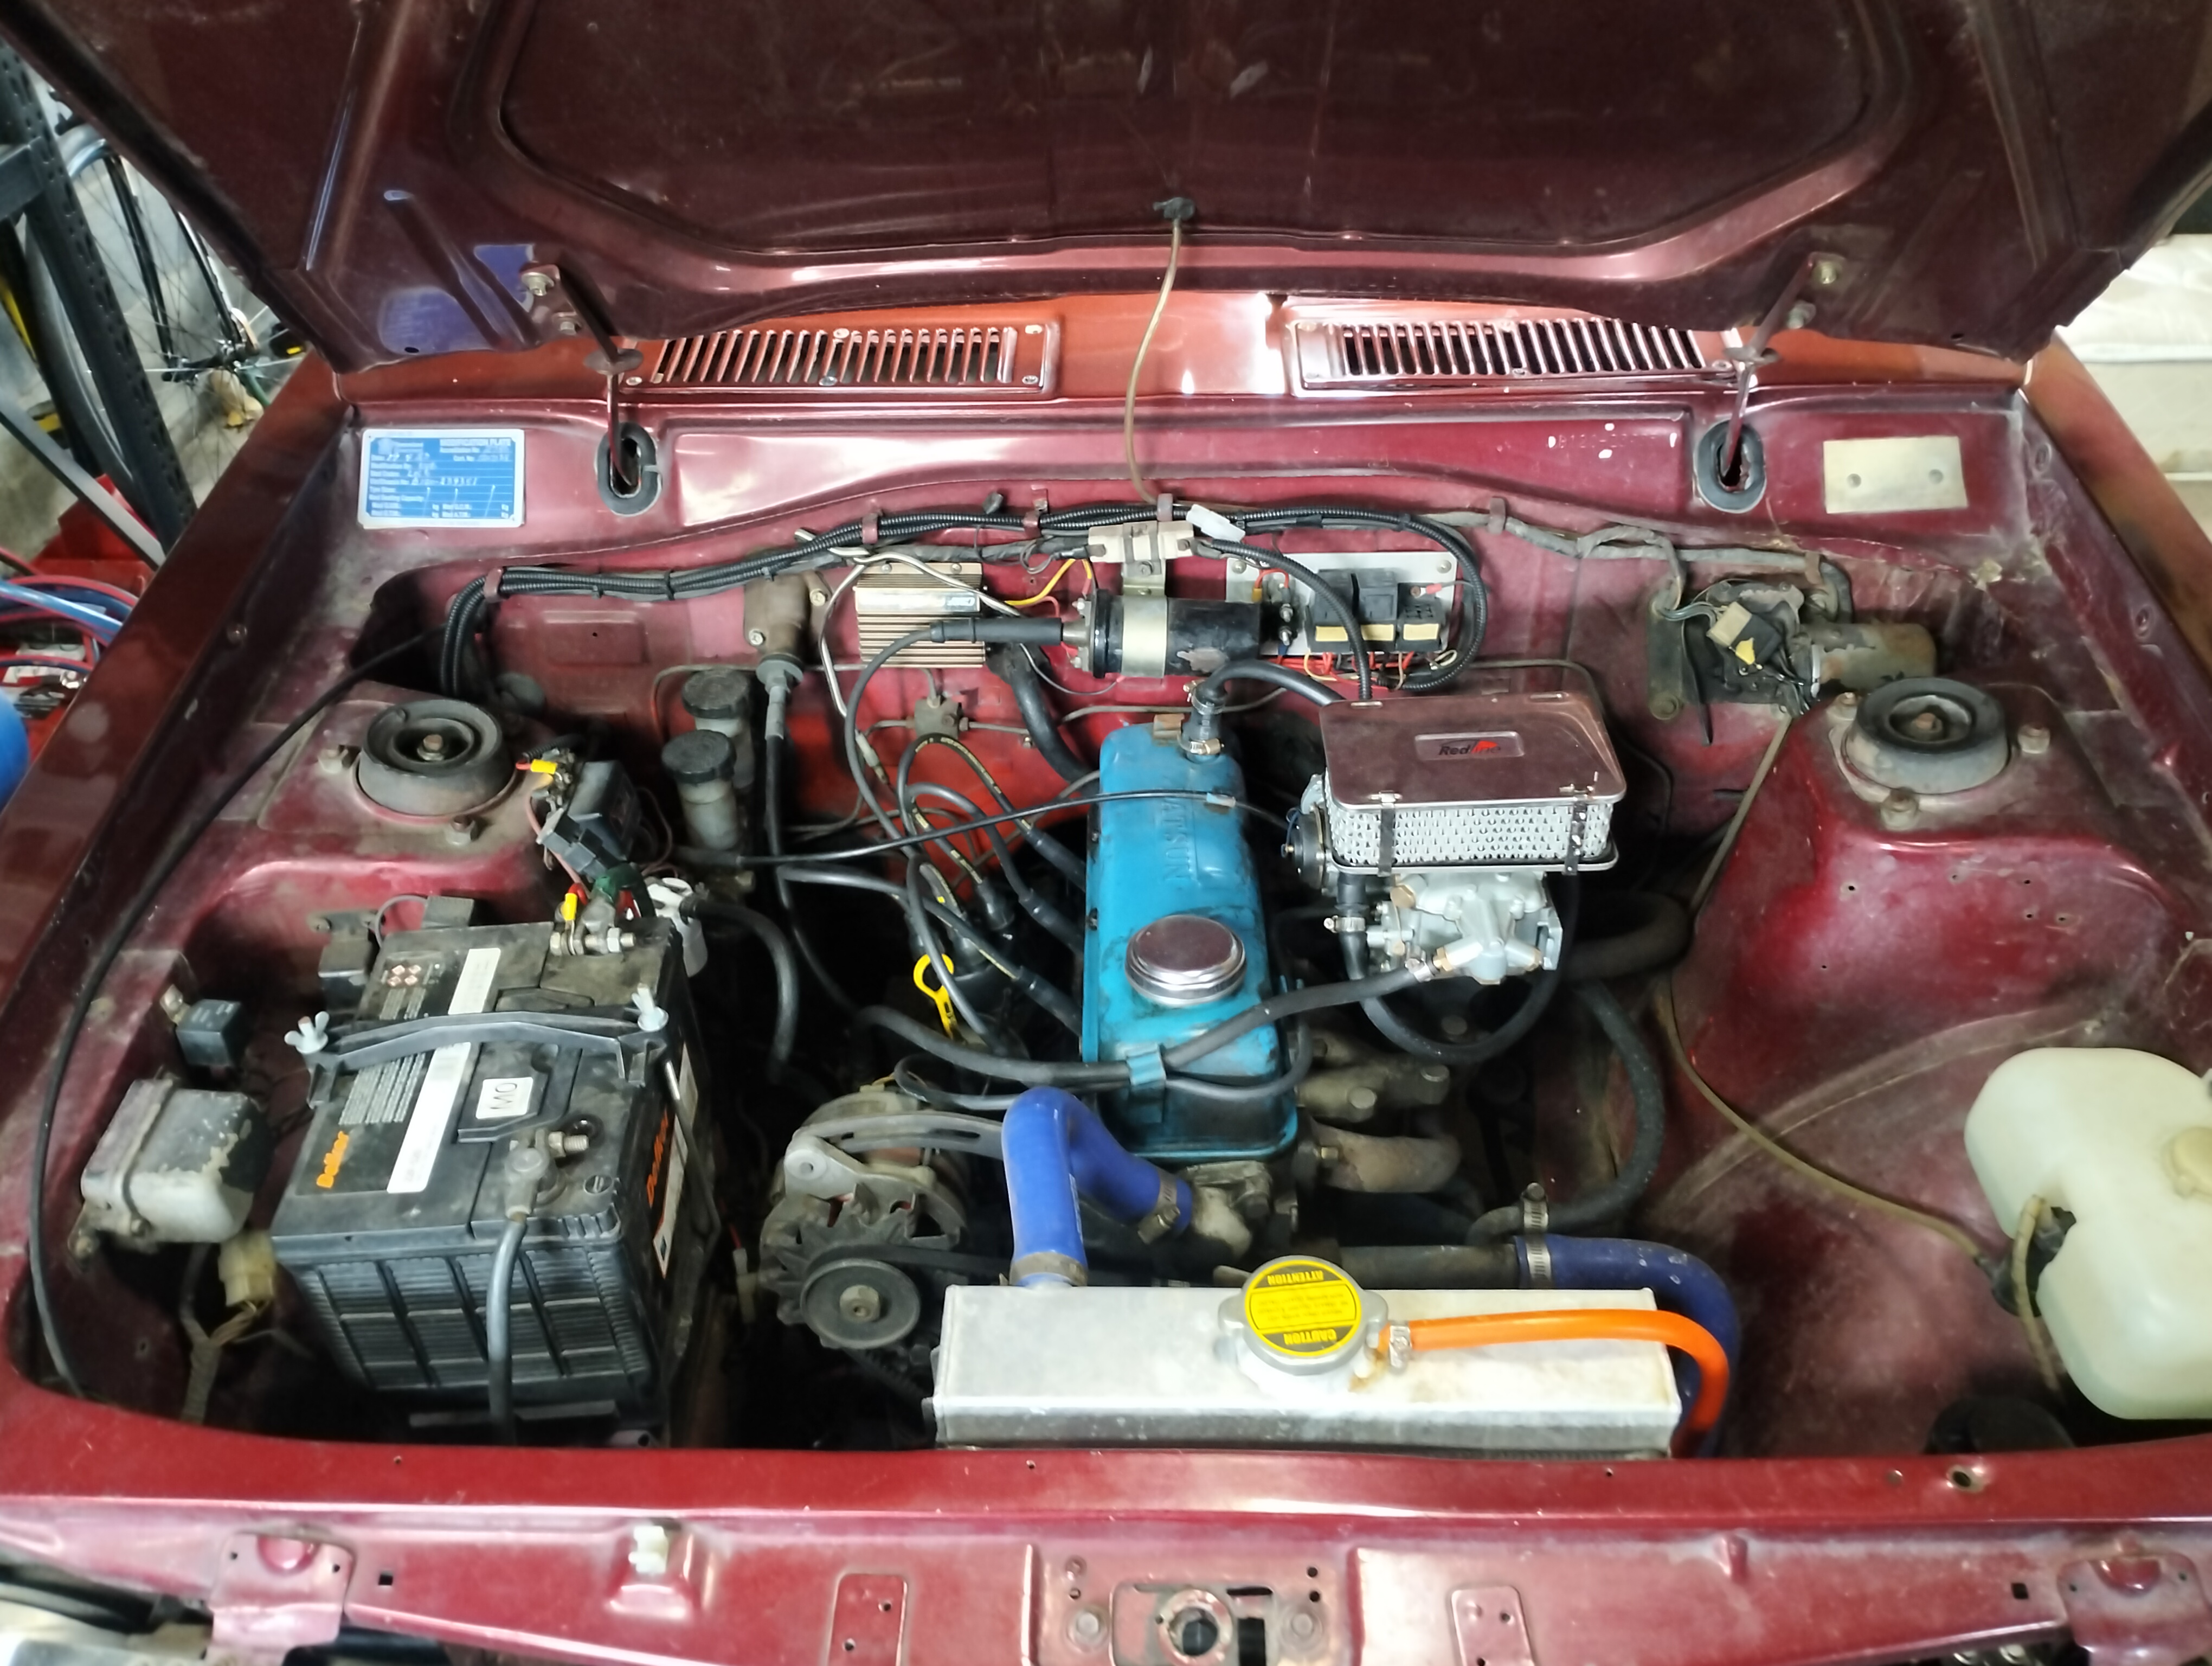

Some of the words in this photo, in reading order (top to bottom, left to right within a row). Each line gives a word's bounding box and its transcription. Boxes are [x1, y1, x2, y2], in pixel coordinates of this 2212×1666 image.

[1162, 781, 1191, 881] ATSUN
[1267, 1270, 1324, 1286] ATTENTION
[1283, 1329, 1337, 1345] CAUTION
